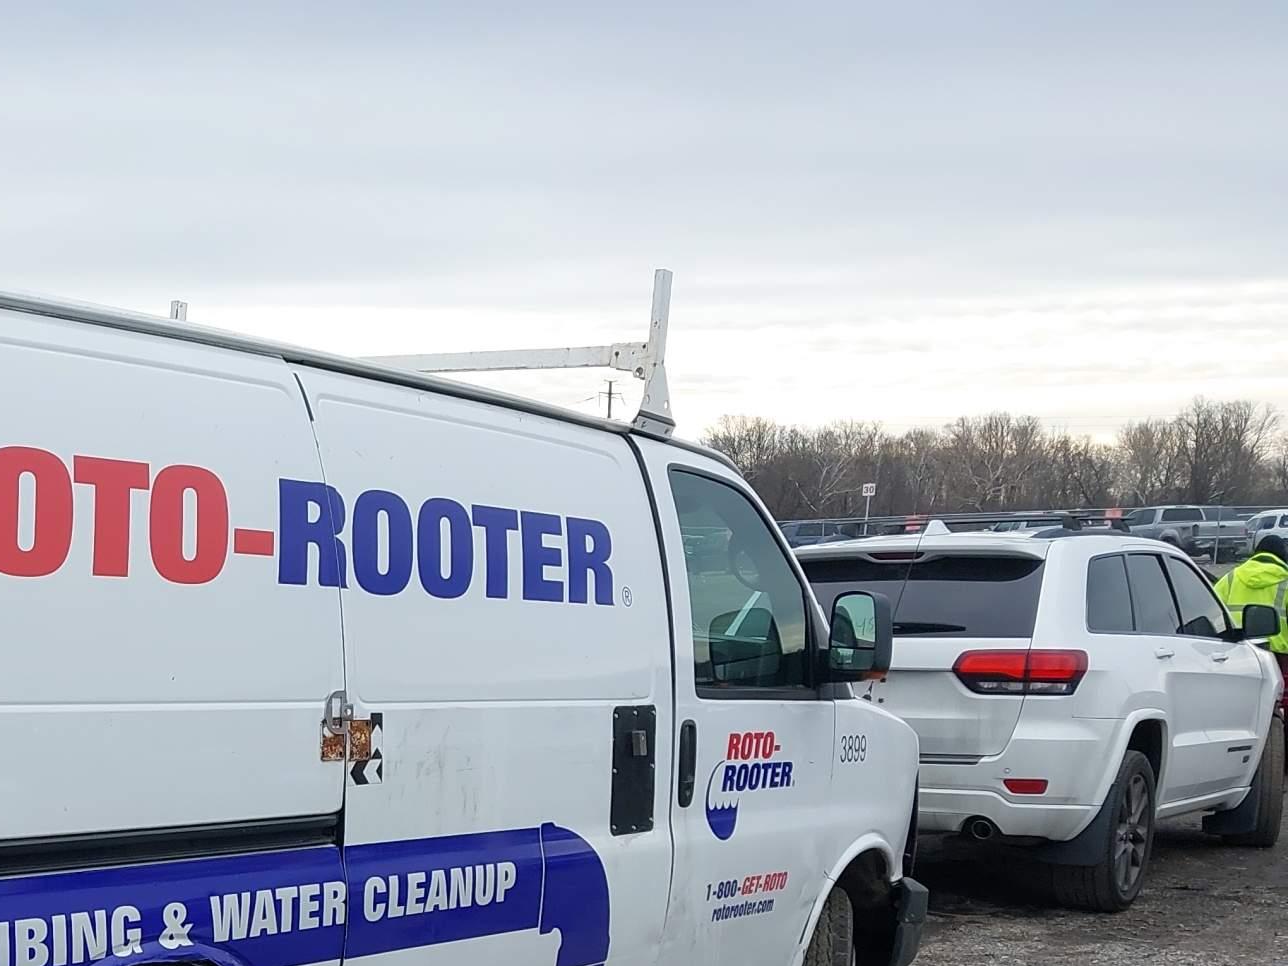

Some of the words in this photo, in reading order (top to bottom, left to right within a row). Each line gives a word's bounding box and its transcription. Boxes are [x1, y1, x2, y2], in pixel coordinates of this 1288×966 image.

[863, 486, 875, 494] 30
[726, 731, 781, 760] ROTO-
[839, 734, 867, 763] 3899
[721, 762, 793, 792] ROOTER
[705, 871, 788, 901] 1-800-GET-ROTO
[158, 901, 194, 950] &
[210, 880, 347, 943] WATER
[363, 861, 518, 923] CLEANUP
[712, 899, 775, 922] rotorooter.com
